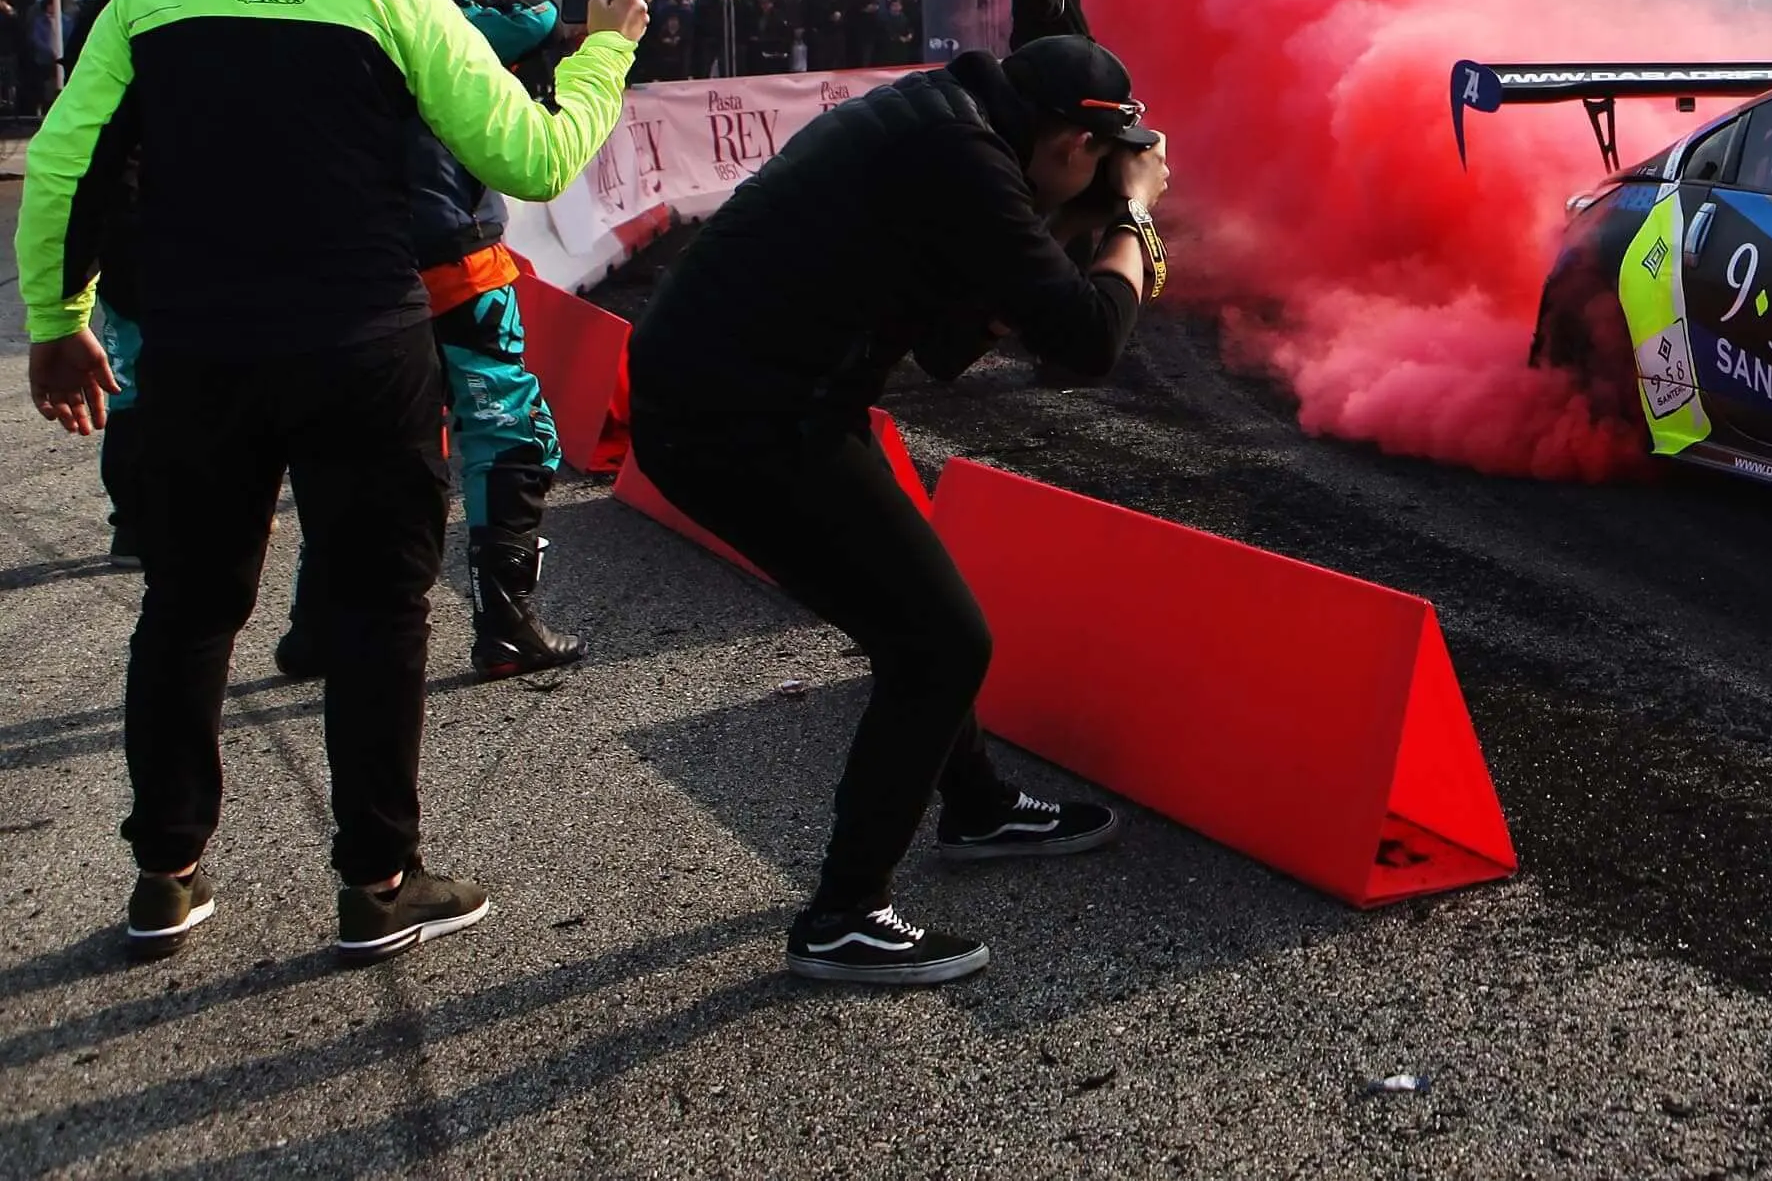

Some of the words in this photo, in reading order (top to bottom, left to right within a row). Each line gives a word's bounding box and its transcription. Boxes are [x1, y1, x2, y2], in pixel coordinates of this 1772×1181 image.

[708, 90, 743, 112] Pasta
[821, 81, 850, 101] Pasta
[707, 109, 780, 169] REY
